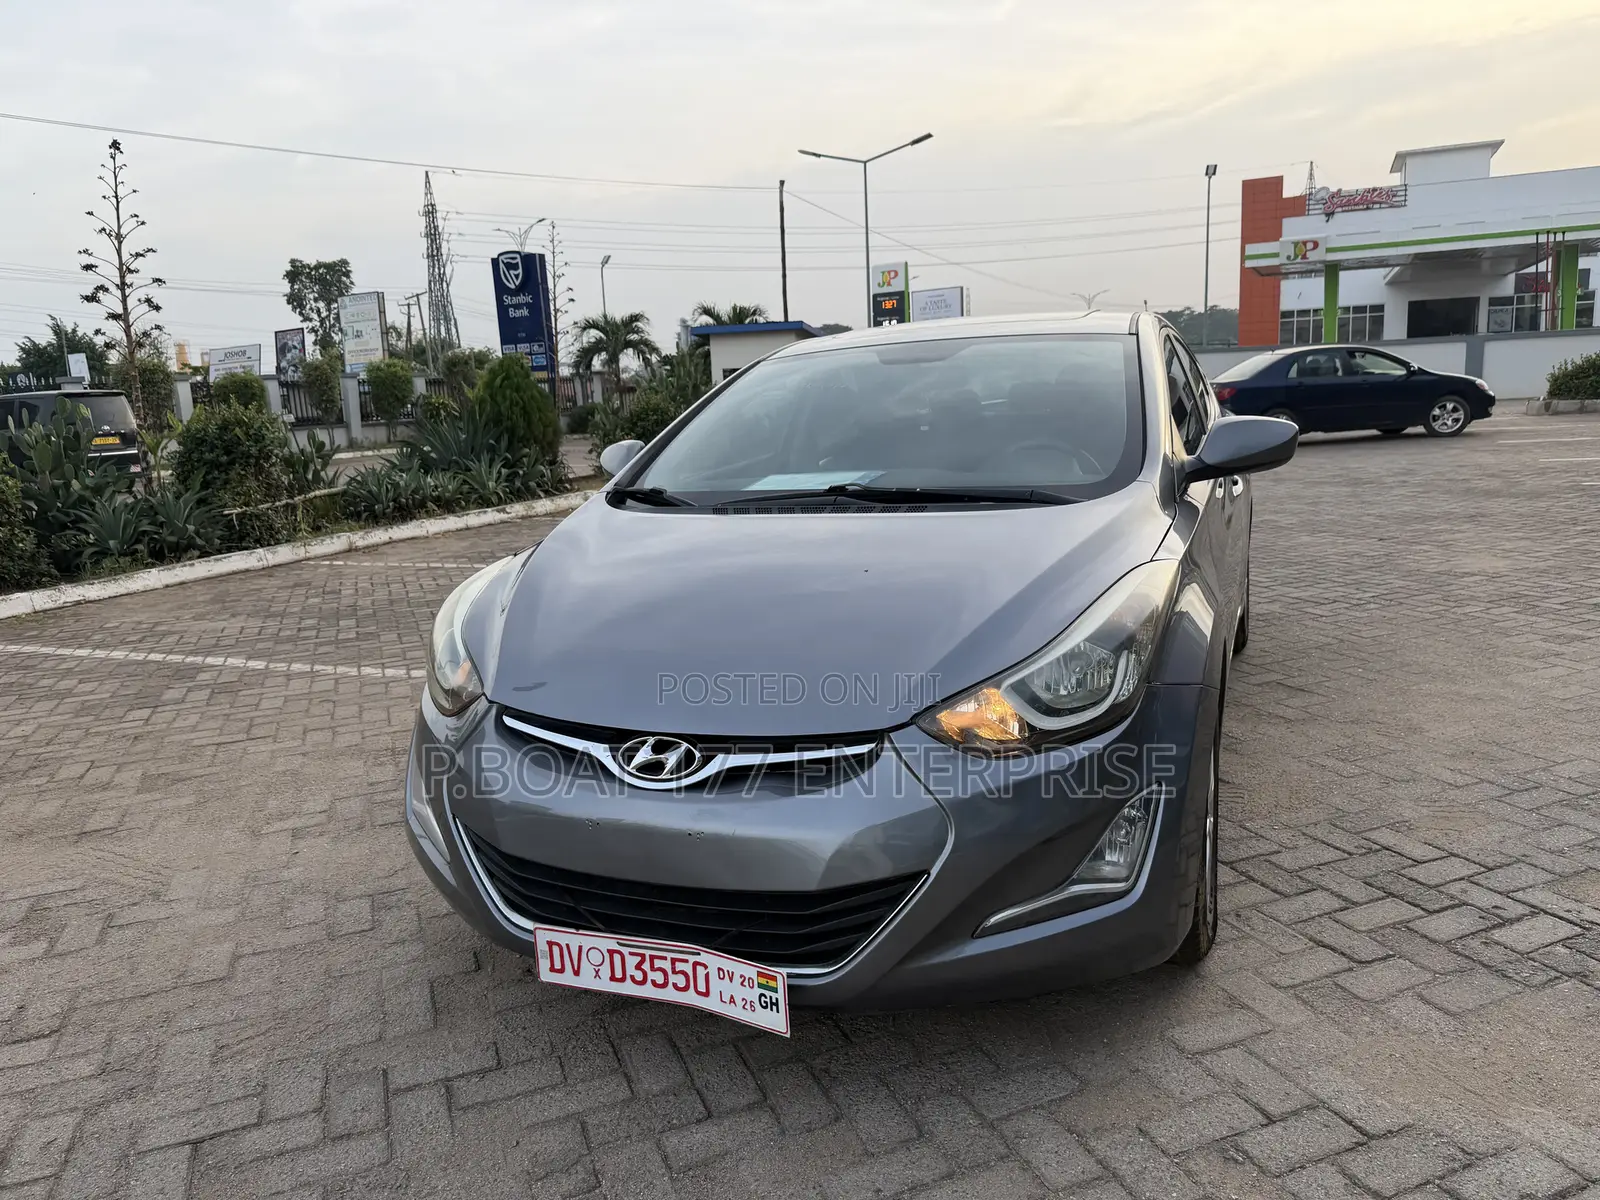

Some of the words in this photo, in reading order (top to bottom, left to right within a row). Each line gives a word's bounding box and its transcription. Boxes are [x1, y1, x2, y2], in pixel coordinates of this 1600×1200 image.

[503, 293, 533, 305] Stanbic
[508, 306, 530, 318] Bank
[546, 940, 583, 977] DV
[606, 948, 711, 998] D3550
[717, 967, 735, 983] DV
[739, 974, 755, 990] 20
[719, 990, 737, 1007] LA
[741, 998, 757, 1013] 26
[758, 992, 780, 1013] GH
